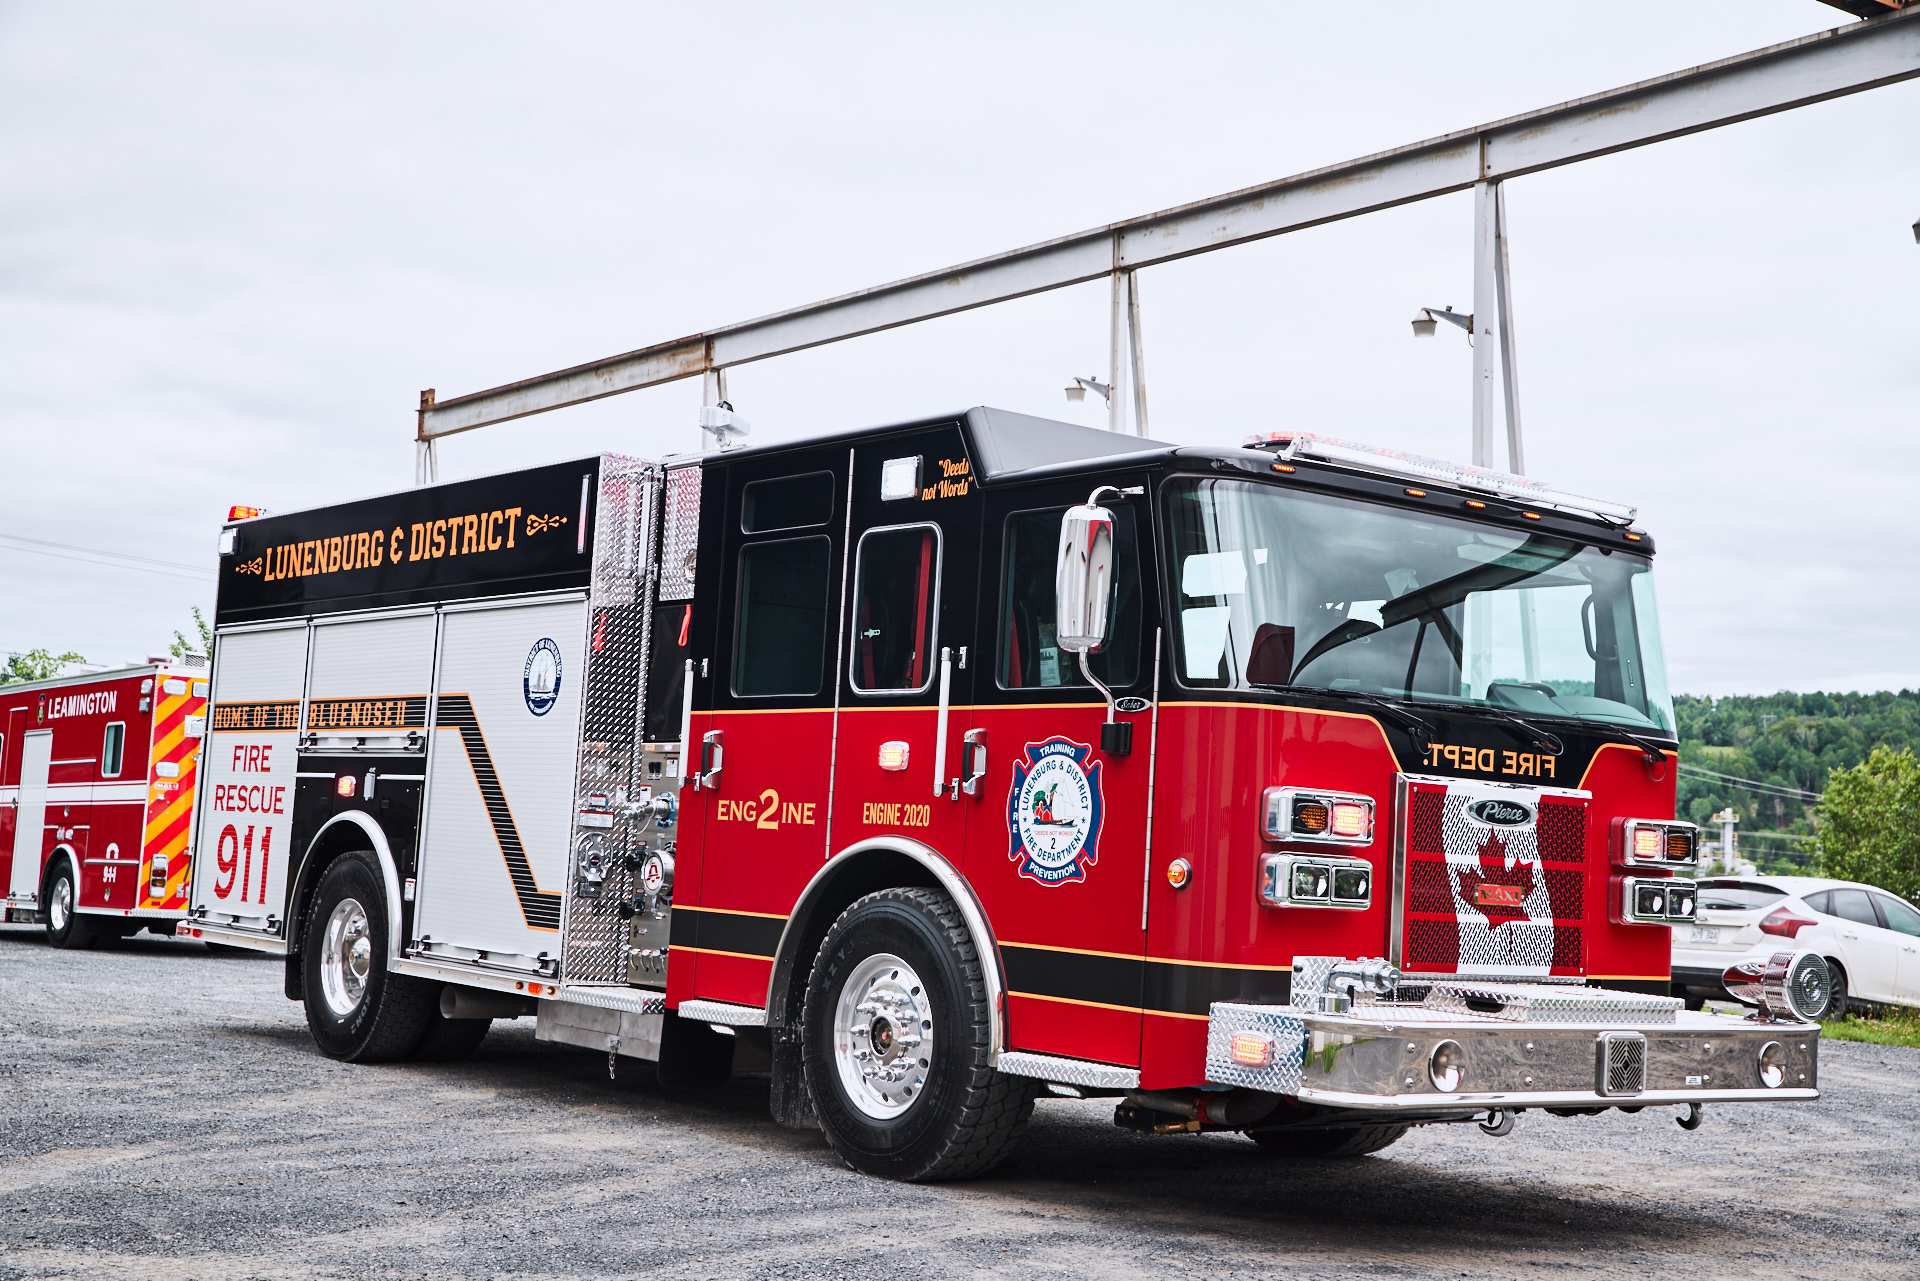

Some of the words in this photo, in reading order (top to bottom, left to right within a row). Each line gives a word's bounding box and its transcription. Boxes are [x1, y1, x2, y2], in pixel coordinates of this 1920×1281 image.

[938, 457, 970, 478] "Deeds
[921, 483, 937, 501] not
[938, 476, 974, 499] Words"
[264, 529, 385, 582] LUNENBURG
[389, 526, 405, 565] &
[409, 507, 522, 562] DISTRICT
[47, 690, 118, 719] LEAMINGTON
[214, 706, 250, 729] HOME
[253, 706, 270, 728] OF
[274, 705, 300, 728] THE
[232, 744, 273, 773] FIRE
[1039, 743, 1076, 758] TRAINING
[1021, 759, 1057, 811] LUNENBURG
[1058, 760, 1064, 771] &
[1066, 763, 1089, 811] DISTRICT
[213, 784, 286, 815] RESCUE
[1012, 787, 1020, 834] FIRE
[1482, 801, 1524, 821] Pierce
[862, 802, 901, 826] ENGINE
[903, 803, 931, 827] 2020
[1023, 827, 1038, 852] FIRE
[1036, 828, 1084, 863] DEPARTMENT
[1050, 837, 1056, 850] 2
[213, 823, 273, 905] 911
[1028, 861, 1076, 880] PREVENTION
[1480, 888, 1519, 902] MAXI
